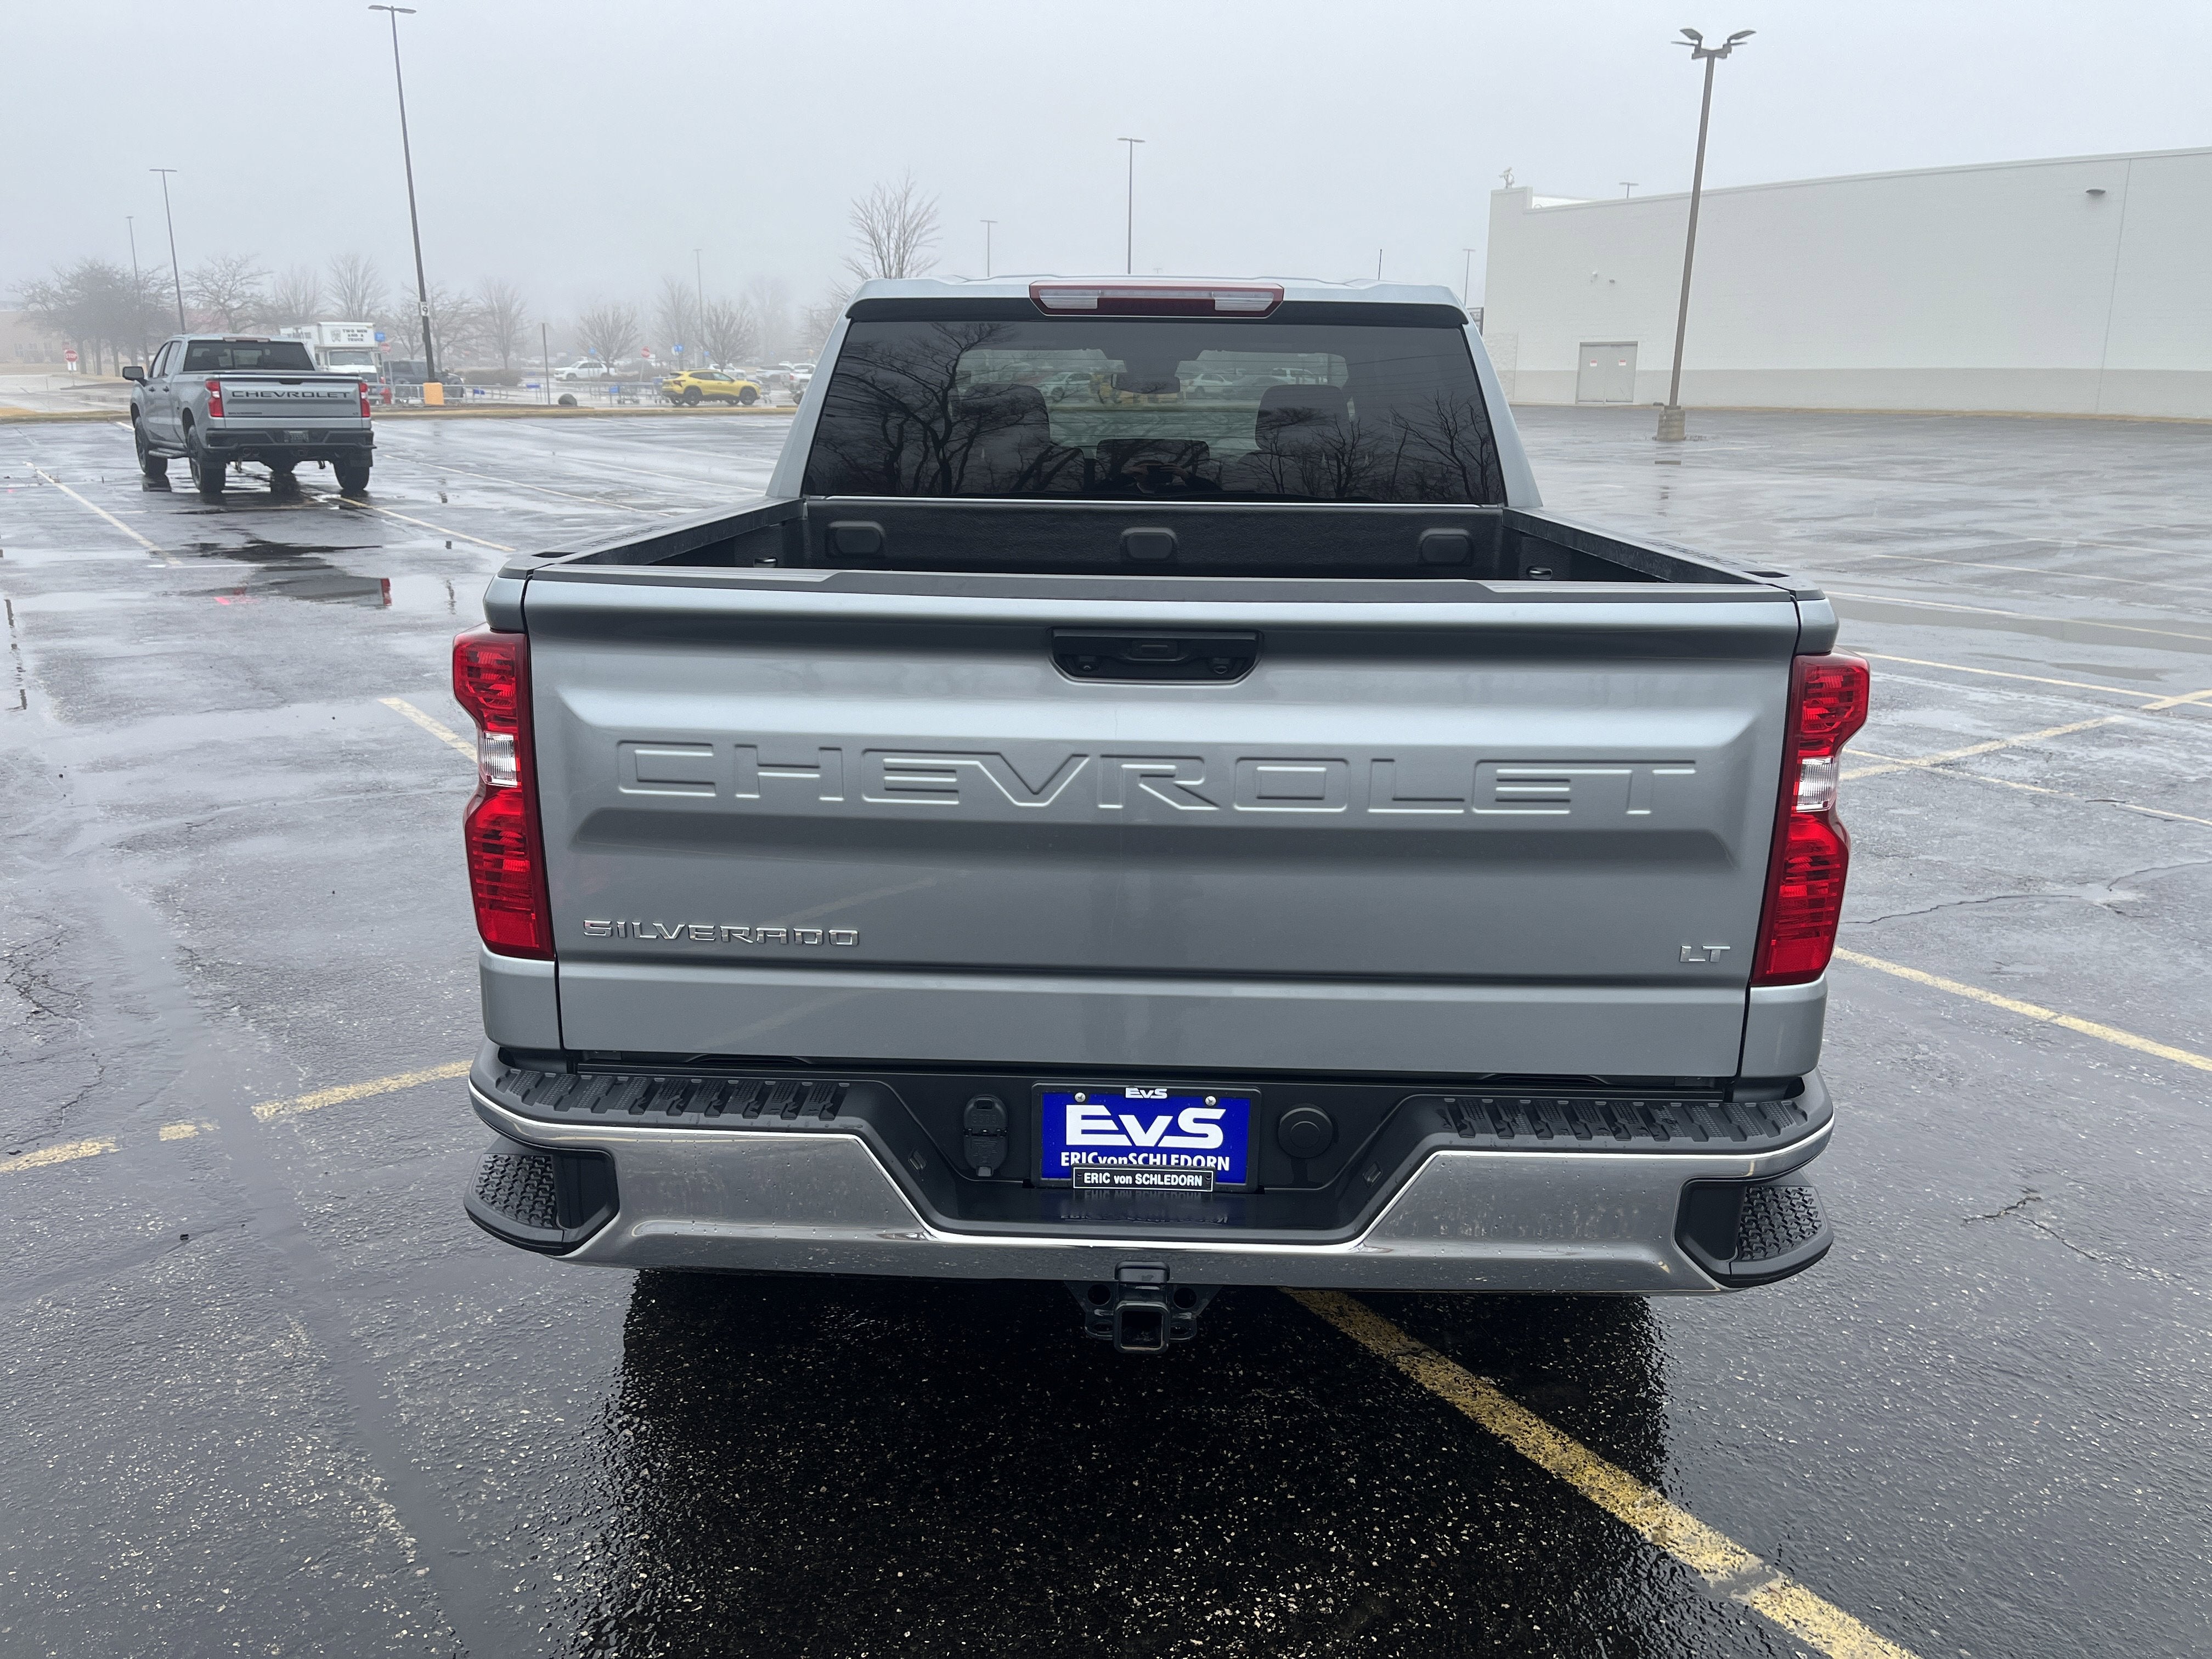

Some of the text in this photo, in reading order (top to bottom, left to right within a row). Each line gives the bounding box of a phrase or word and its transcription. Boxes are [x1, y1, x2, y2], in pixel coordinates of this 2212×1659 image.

[422, 306, 428, 315] 9
[617, 740, 1697, 816] CHEVROLET
[583, 919, 859, 946] SILVERADO
[1679, 945, 1731, 963] LT
[1084, 1172, 1203, 1187] ERIC von SCHLEDORN
